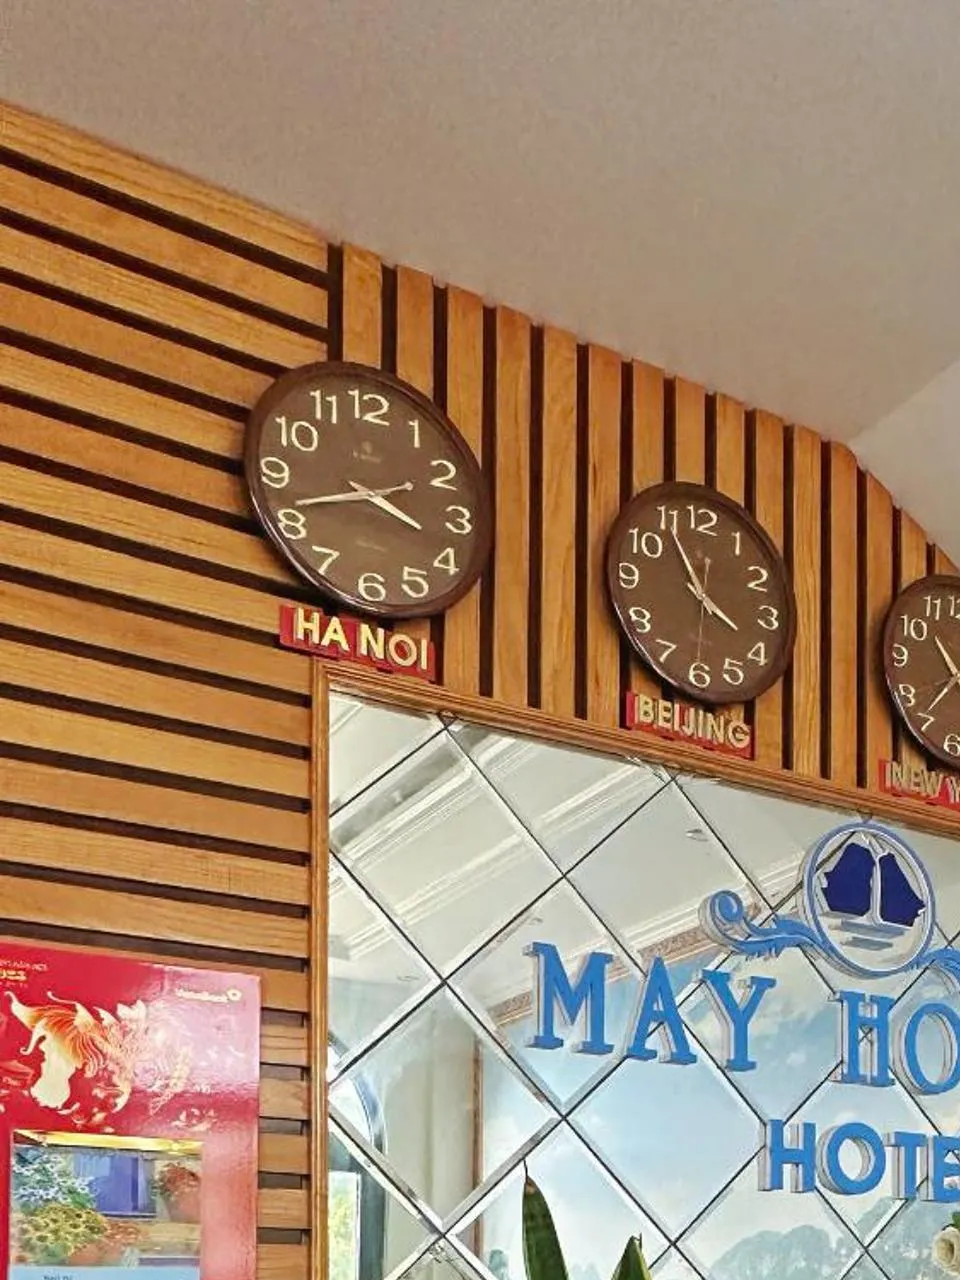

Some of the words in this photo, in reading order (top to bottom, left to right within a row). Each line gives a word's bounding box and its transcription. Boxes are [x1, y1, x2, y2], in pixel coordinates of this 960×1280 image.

[310, 390, 337, 424] 11
[348, 389, 390, 426] 12
[276, 416, 318, 451] 10
[409, 420, 420, 448] 1
[260, 456, 290, 488] 9
[429, 460, 457, 490] 2
[277, 509, 307, 540] 8
[445, 506, 472, 535] 3
[657, 505, 678, 534] 11
[687, 505, 718, 536] 12
[629, 528, 662, 559] 10
[732, 532, 741, 556] 1
[312, 545, 340, 575] 7
[433, 548, 459, 575] 4
[357, 573, 387, 602] 6
[401, 566, 428, 598] 5
[619, 562, 639, 589] 9
[747, 566, 769, 592] 2
[629, 607, 651, 633] 8
[757, 605, 779, 630] 3
[923, 595, 941, 620] 11
[901, 616, 927, 640] 10
[656, 639, 677, 663] 7
[748, 642, 767, 666] 4
[892, 644, 909, 667] 9
[688, 662, 711, 688] 6
[723, 658, 744, 685] 5
[898, 684, 916, 707] 8
[638, 694, 752, 748] BEIJING
[916, 712, 935, 732] 7
[886, 761, 944, 796] NEW
[524, 941, 776, 1072] MAY
